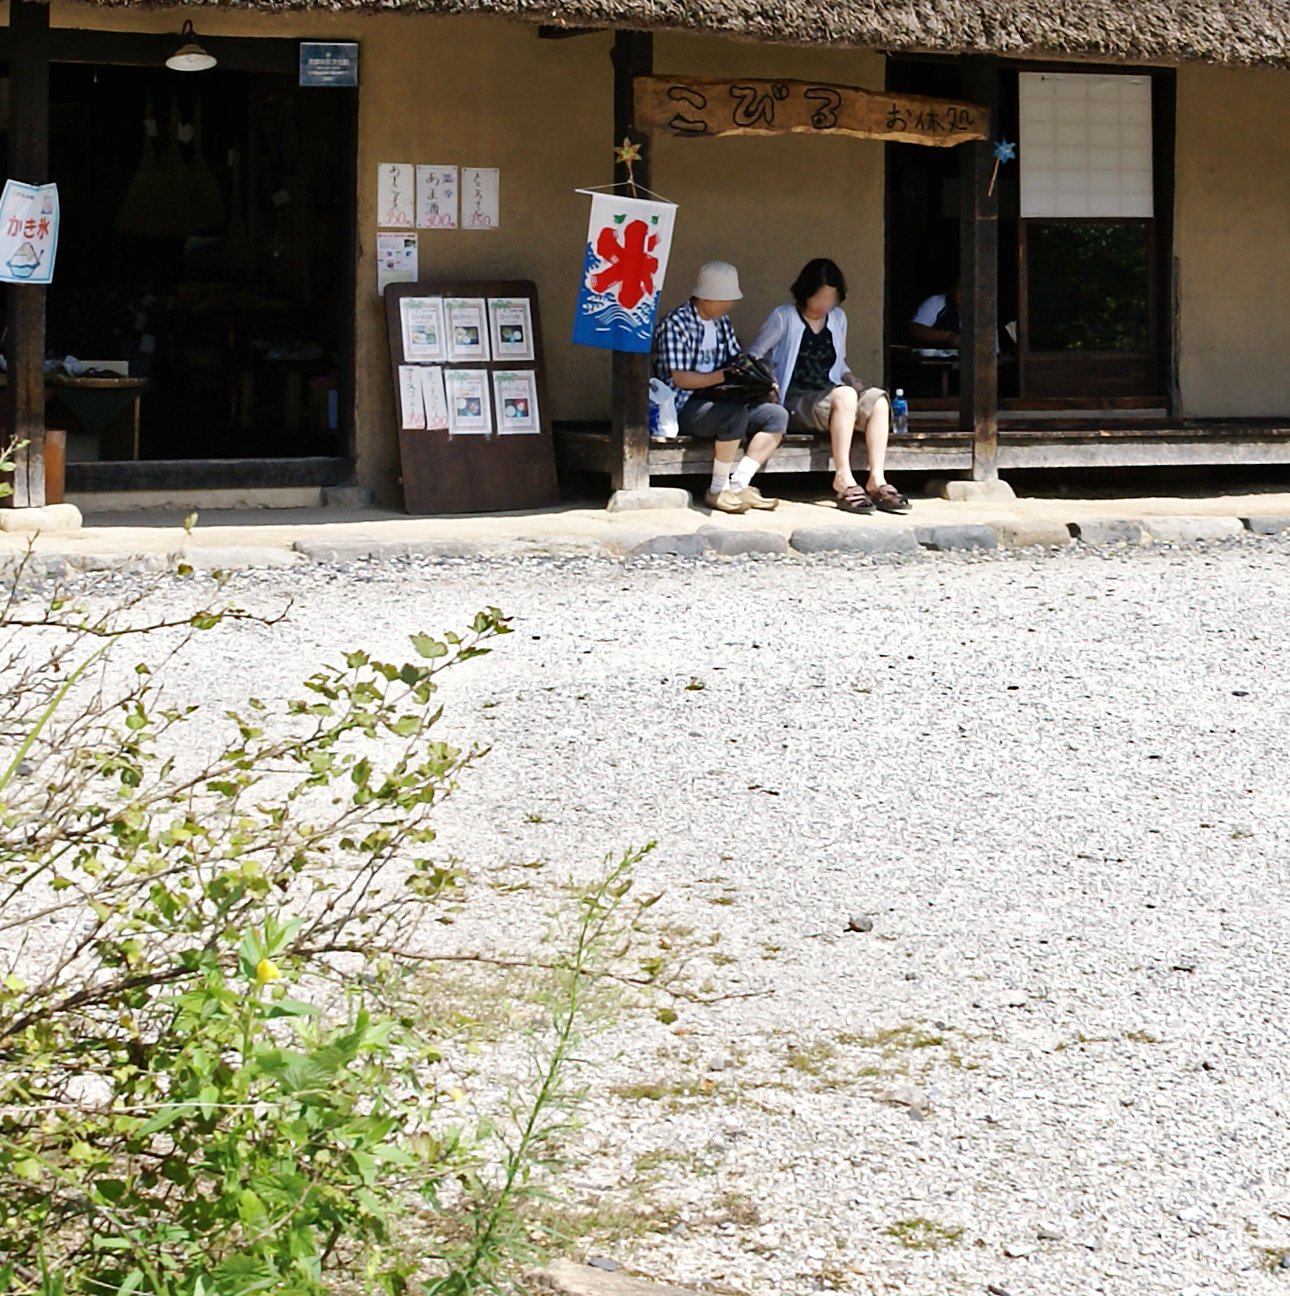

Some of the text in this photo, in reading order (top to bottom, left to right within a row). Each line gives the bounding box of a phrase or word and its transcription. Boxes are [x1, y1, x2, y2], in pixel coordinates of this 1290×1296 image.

[667, 85, 975, 133] こびる お休処
[7, 215, 50, 240] かき氷
[591, 219, 661, 309] 氷
